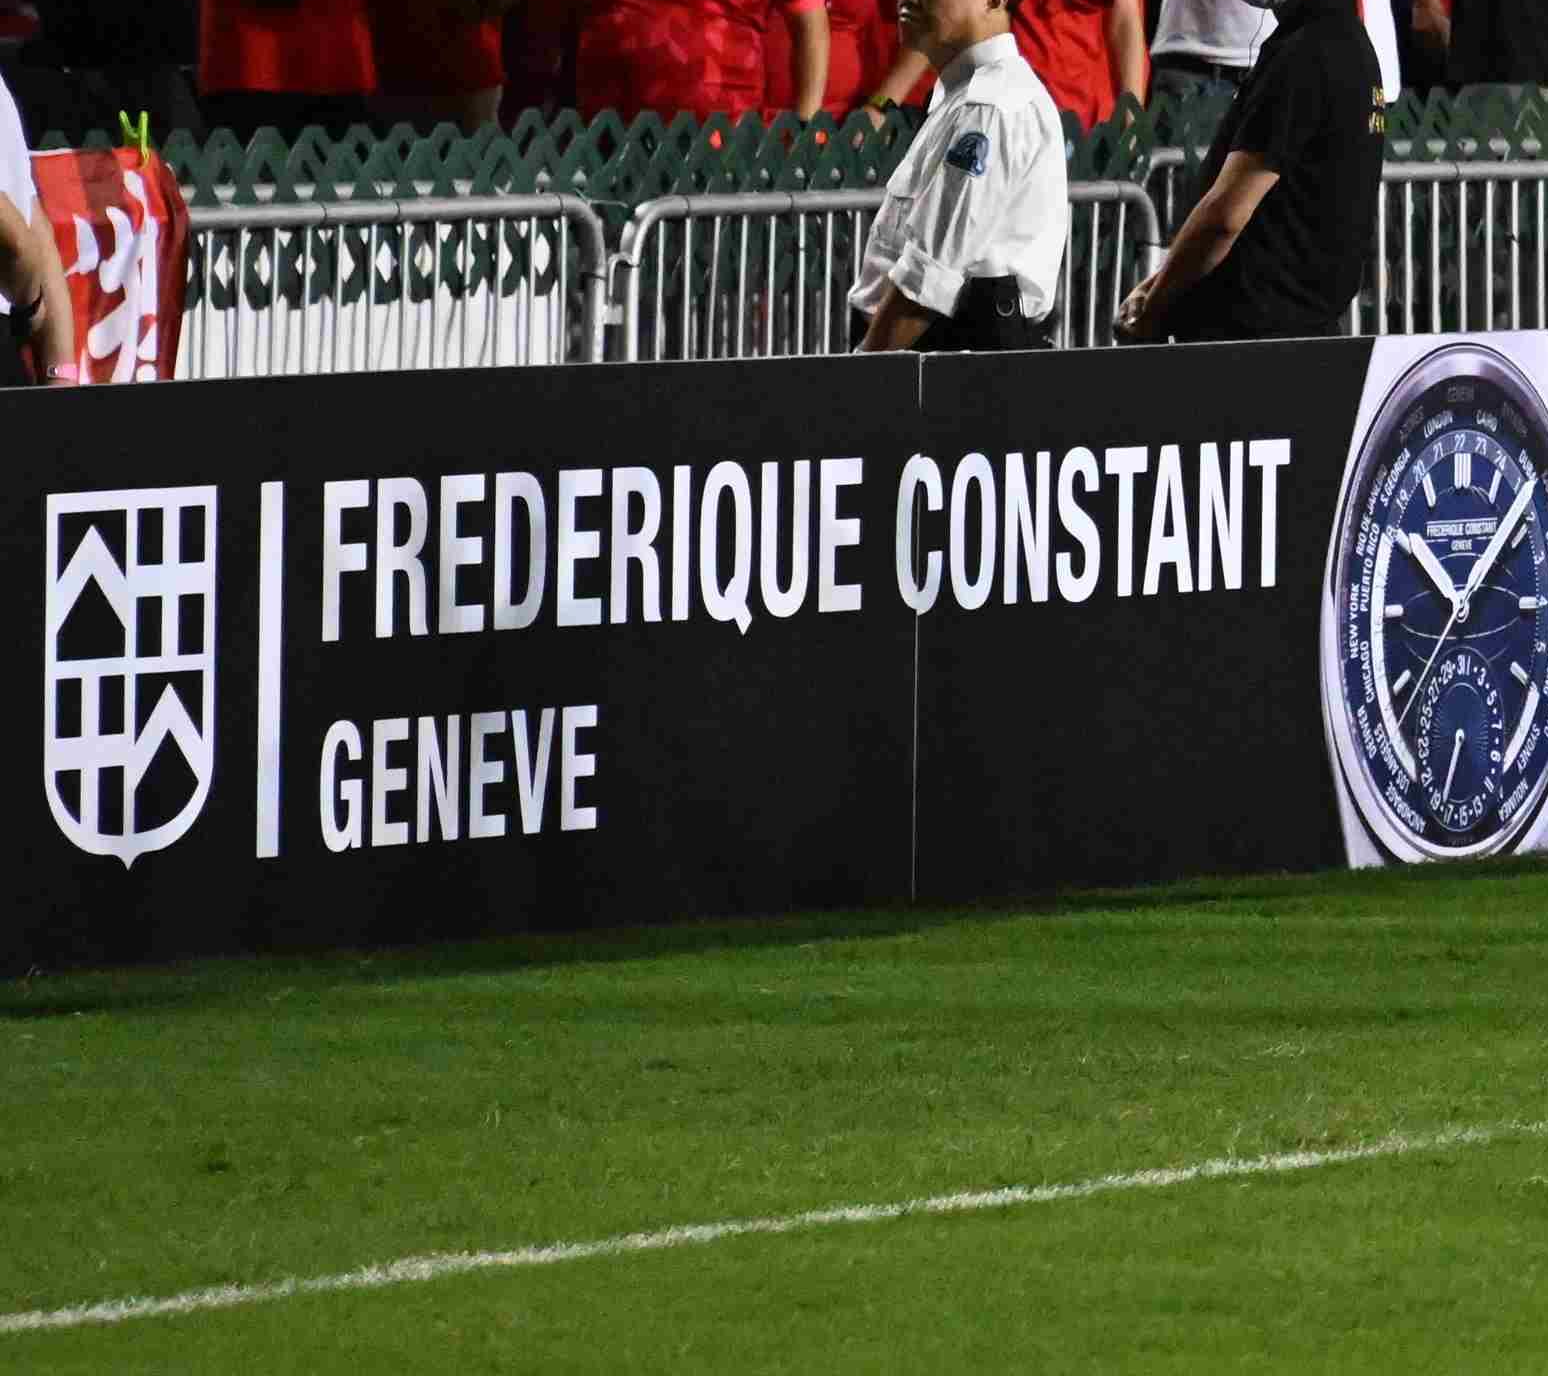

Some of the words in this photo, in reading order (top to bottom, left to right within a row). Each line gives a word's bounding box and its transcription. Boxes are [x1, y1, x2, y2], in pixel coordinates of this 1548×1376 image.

[1454, 433, 1466, 452] 22
[321, 457, 864, 637] FREDERIQUE
[895, 437, 1291, 616] CONSTANT
[1359, 556, 1374, 612] PUERTO
[1367, 522, 1381, 558] RICO
[1350, 583, 1360, 615] YORK
[1350, 626, 1360, 660] NEW
[1359, 640, 1376, 704] CHICAGO
[1356, 704, 1377, 760] DENVER
[1516, 722, 1541, 774] SYDNEY
[319, 704, 598, 854] GENEVE
[1498, 777, 1529, 822] NOUMEA
[1384, 780, 1427, 835] ANCHORAGE
